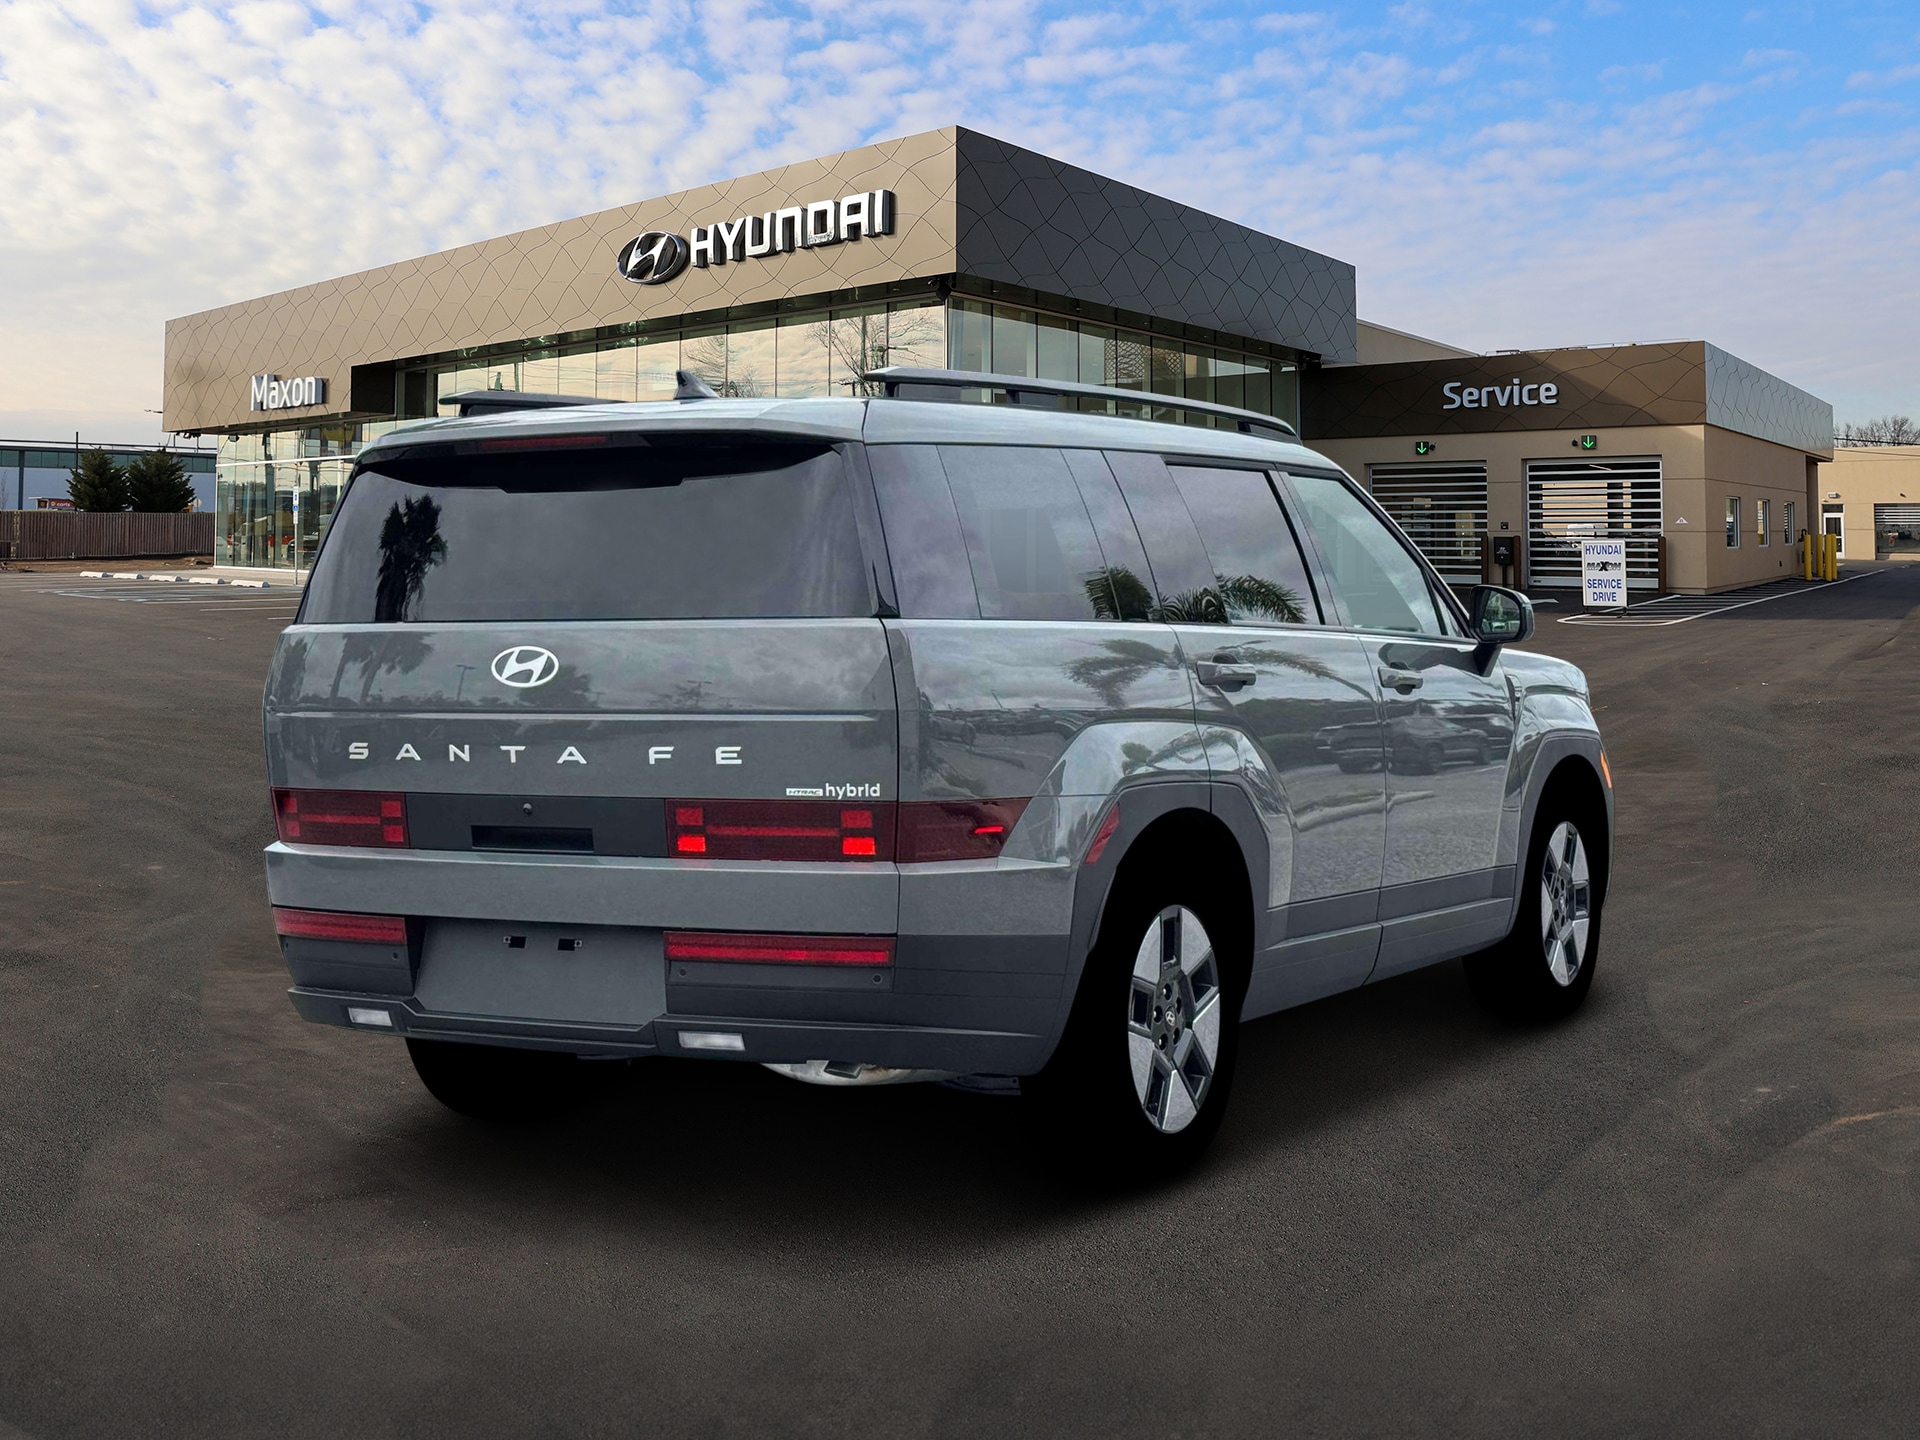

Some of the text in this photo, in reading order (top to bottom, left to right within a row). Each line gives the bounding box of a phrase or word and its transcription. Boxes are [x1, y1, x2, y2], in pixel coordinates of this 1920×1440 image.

[690, 189, 892, 267] HYUNDAI
[250, 373, 322, 412] Maxon
[1443, 378, 1559, 409] Service
[1585, 545, 1622, 555] HYUNDAI
[1587, 579, 1622, 589] SERVICE
[1592, 592, 1617, 602] DRIVE
[348, 741, 743, 765] SANTA FE
[825, 783, 881, 800] hybrid
